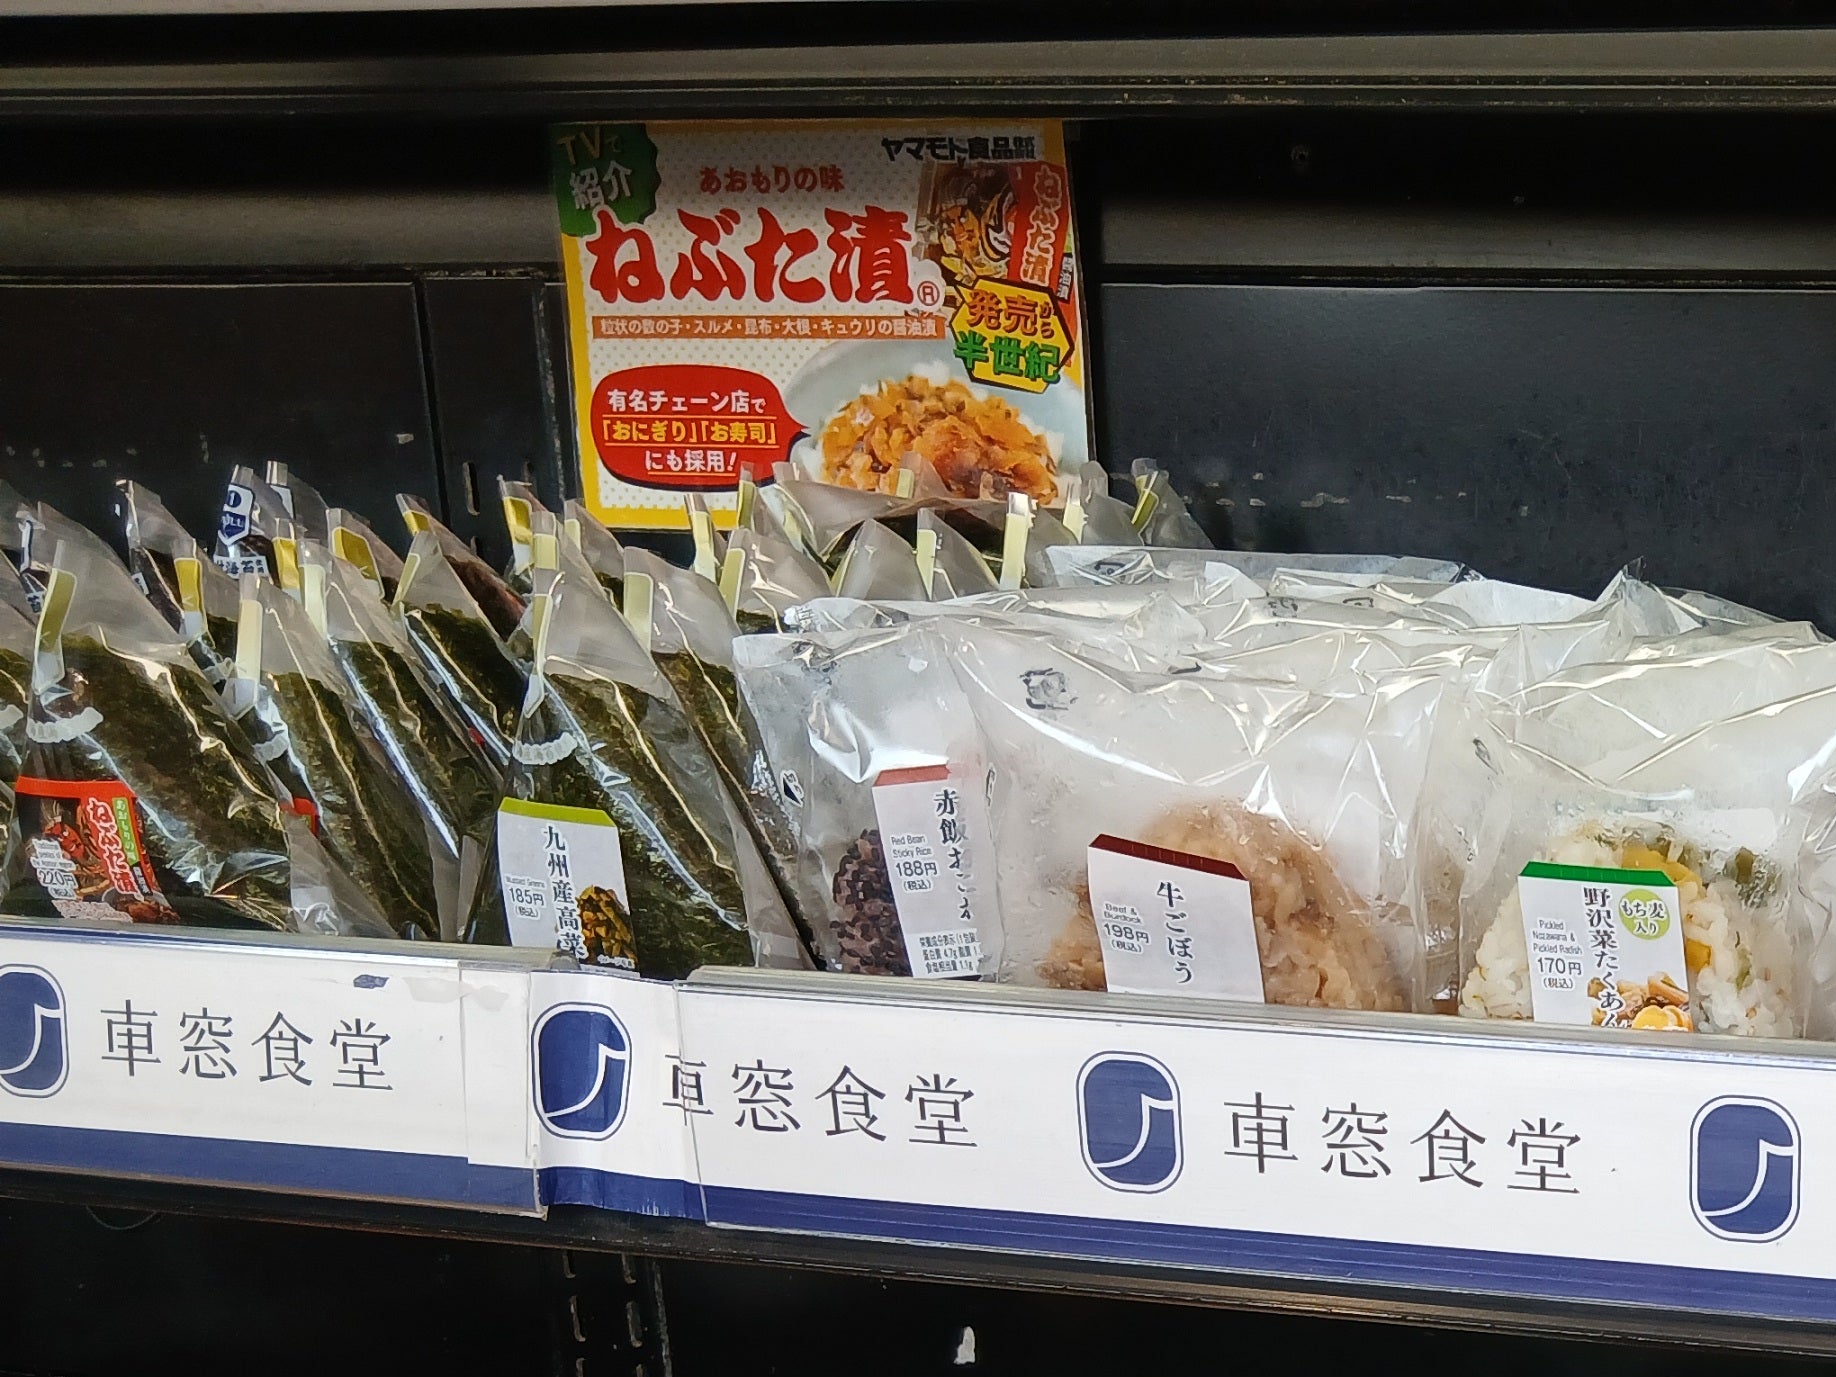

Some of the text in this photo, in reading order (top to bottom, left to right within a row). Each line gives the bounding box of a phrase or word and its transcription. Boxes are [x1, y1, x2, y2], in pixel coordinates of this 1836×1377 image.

[569, 161, 633, 209] 紹介
[700, 164, 845, 194] あおもりの味
[953, 330, 1061, 382] 半世紀
[608, 389, 766, 415] 有名チェーン店で
[896, 861, 938, 878] 188円
[508, 887, 545, 907] 185円
[544, 825, 588, 957] 九州産高菜
[1621, 900, 1666, 919] もち麦
[1103, 923, 1150, 944] 198円
[1157, 881, 1195, 984] 牛ごぼう
[1636, 921, 1657, 935] 入り
[1537, 957, 1582, 976] 170円
[1583, 887, 1624, 1029] 野沢菜たくあん
[100, 999, 394, 1091] 車窓食堂
[661, 1053, 978, 1148] 車窓食堂
[1223, 1091, 1582, 1196] 車窓食堂
